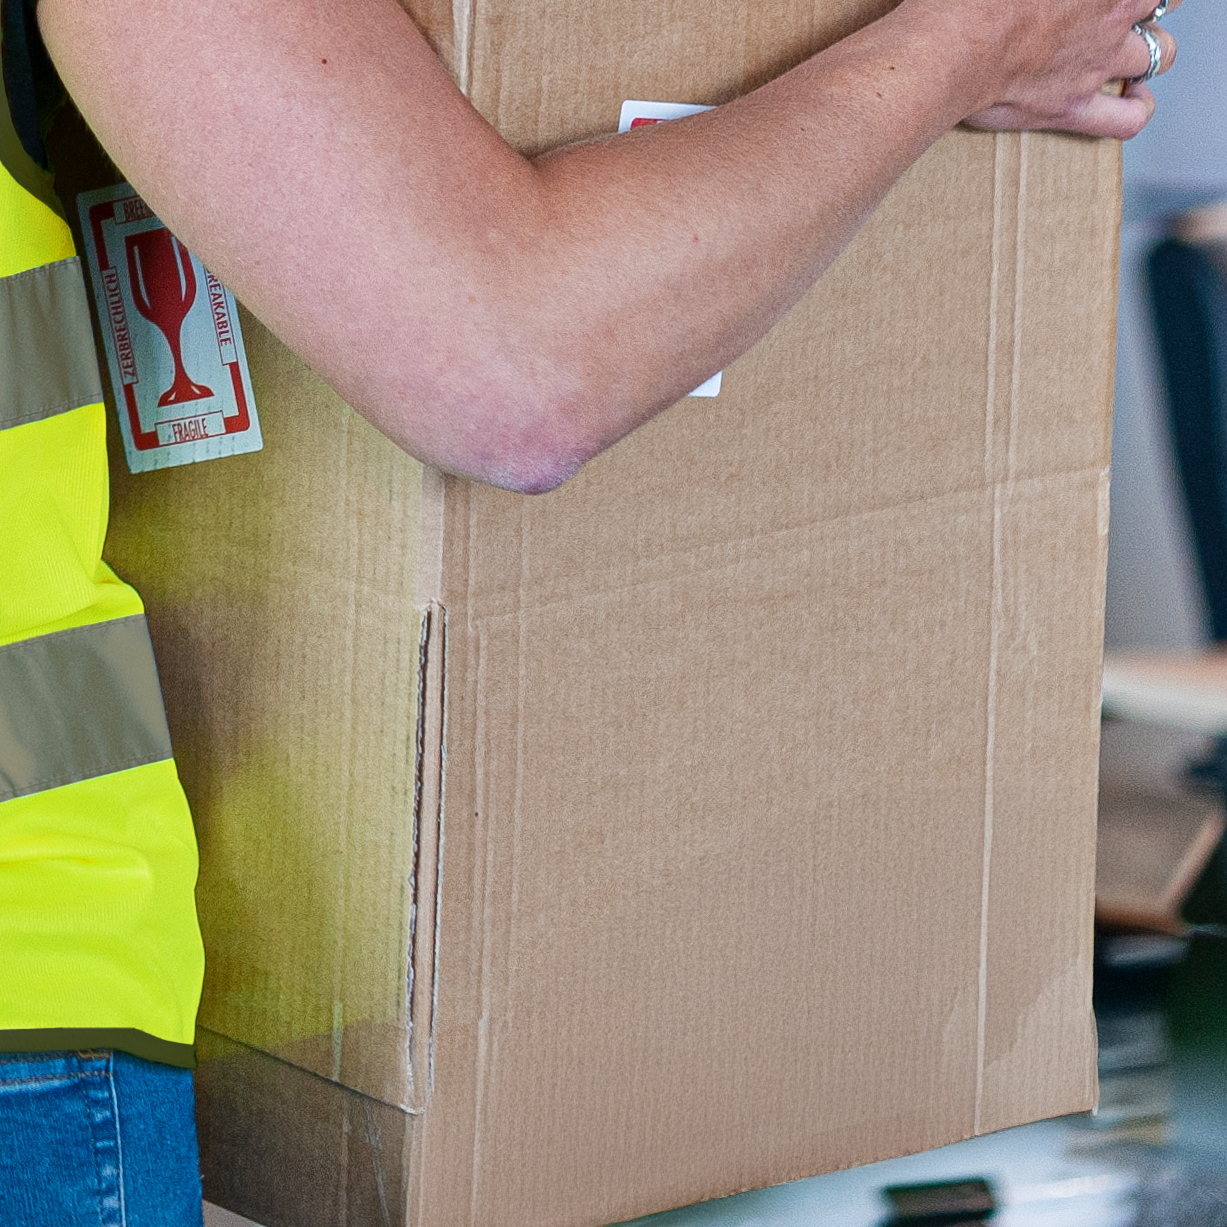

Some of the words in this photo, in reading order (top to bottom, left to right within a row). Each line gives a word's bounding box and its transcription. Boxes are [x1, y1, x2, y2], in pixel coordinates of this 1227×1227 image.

[104, 272, 138, 379] ZERBRECHLICH
[206, 268, 232, 347] REAKABLE
[172, 417, 209, 443] FRAGILE
